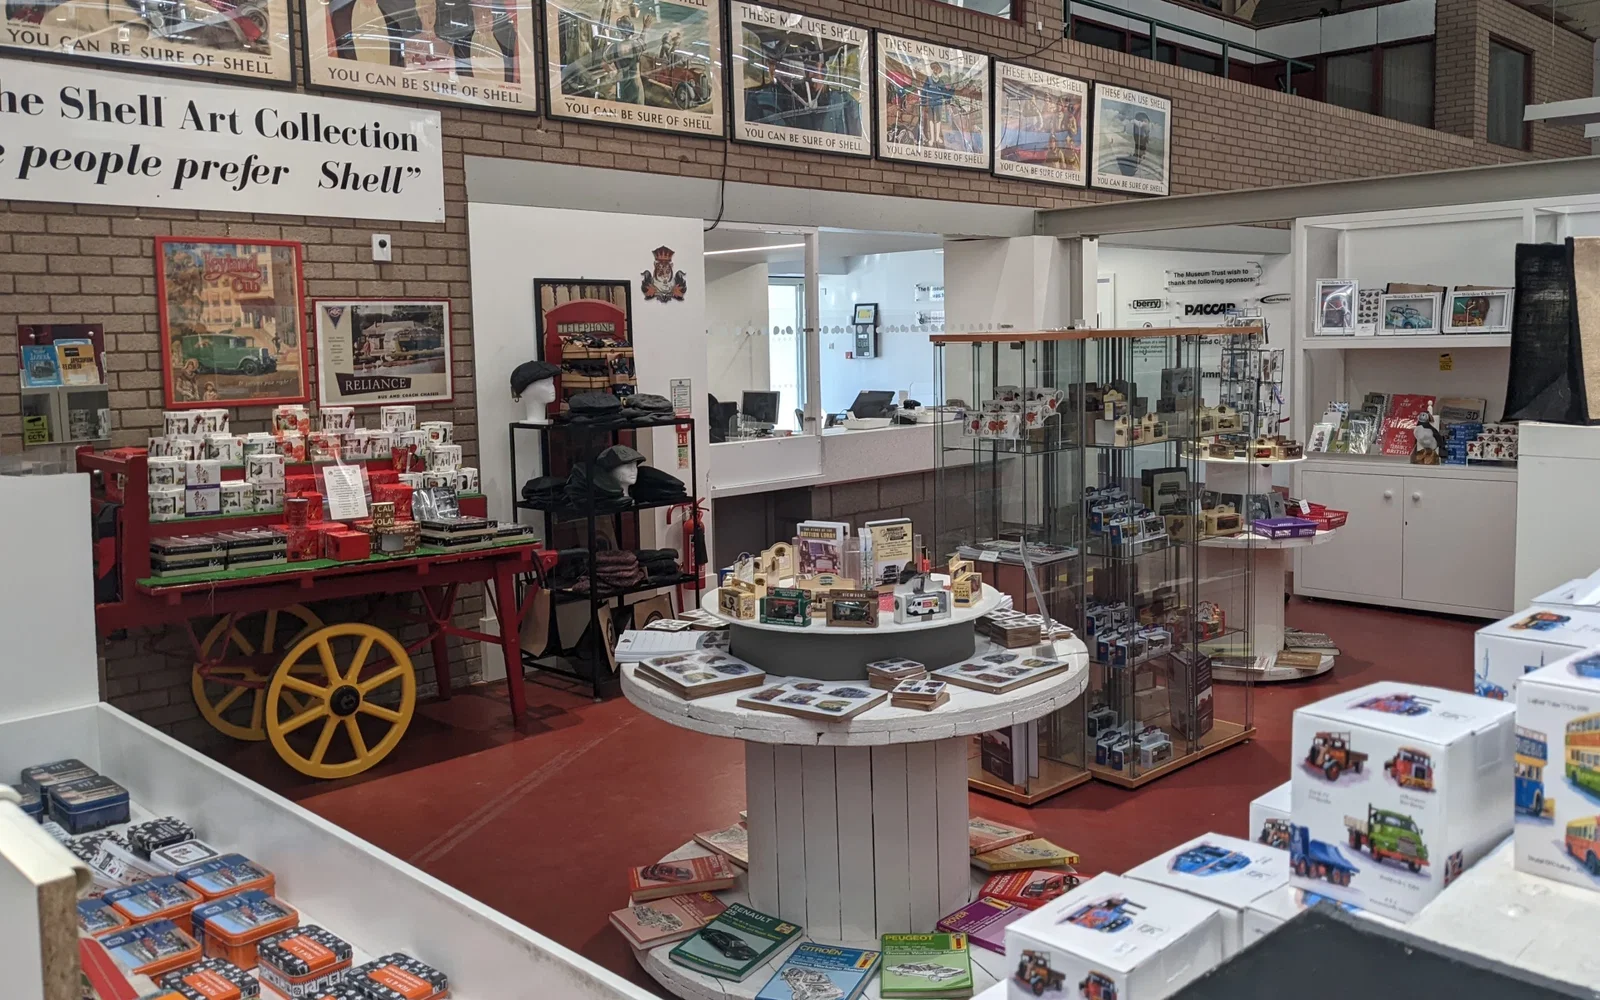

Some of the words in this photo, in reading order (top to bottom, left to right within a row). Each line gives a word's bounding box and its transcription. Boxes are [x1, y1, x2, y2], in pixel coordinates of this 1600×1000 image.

[741, 6, 776, 24] THESE
[780, 16, 802, 30] MN
[808, 20, 826, 34] USE
[7, 28, 50, 46] YOU
[60, 35, 100, 52] CAN
[110, 42, 131, 56] BE
[140, 46, 184, 63] SURE
[193, 53, 214, 67] OF
[224, 56, 274, 74] SHELL
[328, 67, 360, 82] YOU
[366, 73, 396, 87] CAN
[402, 78, 418, 90] BE
[423, 80, 458, 96] SURE
[462, 85, 479, 98] OF
[484, 90, 523, 104] SHELL
[1001, 65, 1025, 80] THESE
[1046, 74, 1060, 88] USE
[1062, 79, 1084, 93] SHELL
[1102, 86, 1120, 100] THESE
[1138, 94, 1148, 104] USE
[1150, 96, 1166, 110] SHELL
[60, 86, 166, 128] Shell
[179, 100, 244, 135] Art
[255, 107, 419, 152] Collection
[565, 102, 589, 114] YOU
[622, 110, 633, 120] BE
[638, 112, 663, 124] SURE
[666, 115, 679, 126] OF
[683, 118, 712, 130] SHELL
[745, 127, 764, 138] YOU
[768, 130, 786, 142] CAN
[790, 133, 799, 144] BE
[802, 135, 823, 146] SURE
[826, 138, 836, 148] OF
[840, 140, 863, 152] SHELL
[886, 144, 903, 155] YOU
[906, 148, 921, 157] CAN
[924, 150, 932, 159] BE
[934, 151, 952, 162] SURE
[954, 154, 963, 163] OF
[965, 154, 984, 164] SHELL
[15, 144, 162, 186] people
[170, 154, 290, 192] prefer
[1000, 162, 1014, 172] YOU
[1016, 164, 1029, 174] CAN
[1030, 166, 1038, 176] BE
[1040, 168, 1054, 178] SURE
[1056, 170, 1063, 179] OF
[1064, 171, 1080, 182] SHELL
[1098, 176, 1108, 185] YOU
[1109, 178, 1120, 188] CAN
[1121, 180, 1128, 188] BE
[1128, 180, 1142, 190] SURE
[1142, 182, 1148, 191] OF
[1150, 183, 1164, 193] SHELL
[1185, 270, 1210, 278] Museum
[1197, 278, 1224, 286] following
[1225, 277, 1256, 286] sponsors:
[1136, 300, 1160, 310] berry
[558, 323, 615, 334] TELEPHONE
[345, 378, 407, 391] RELIANCE
[1466, 412, 1478, 420] 3D
[726, 908, 738, 916] 25
[730, 904, 773, 924] RENAULT
[942, 910, 970, 926] ROVER
